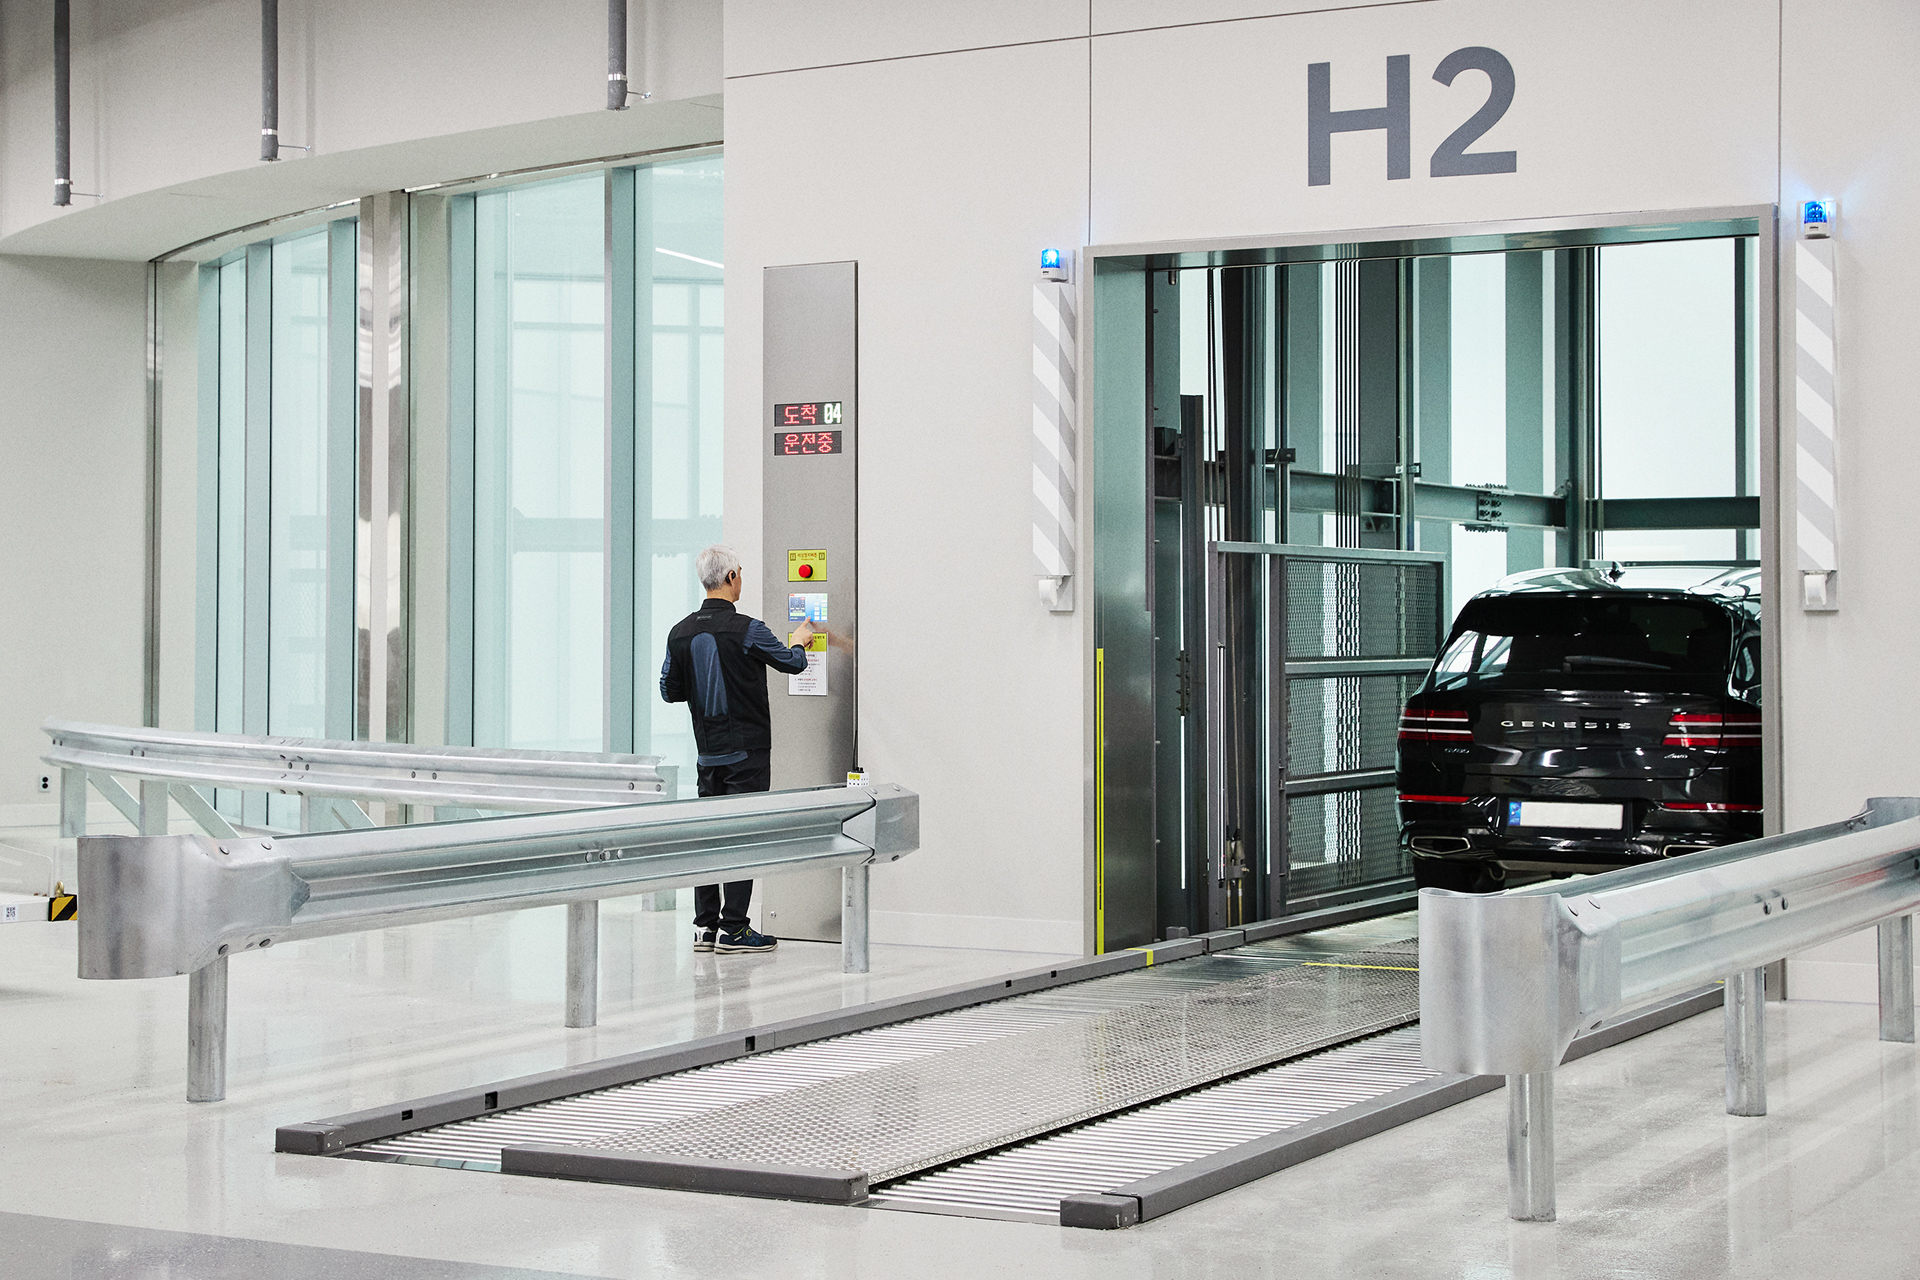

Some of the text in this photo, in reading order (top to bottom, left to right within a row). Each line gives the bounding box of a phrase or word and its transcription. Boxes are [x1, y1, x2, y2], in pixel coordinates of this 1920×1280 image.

[1307, 46, 1517, 186] H2
[784, 403, 841, 424] 도착 04
[784, 432, 833, 454] 운전중
[1500, 720, 1631, 730] GENESIS
